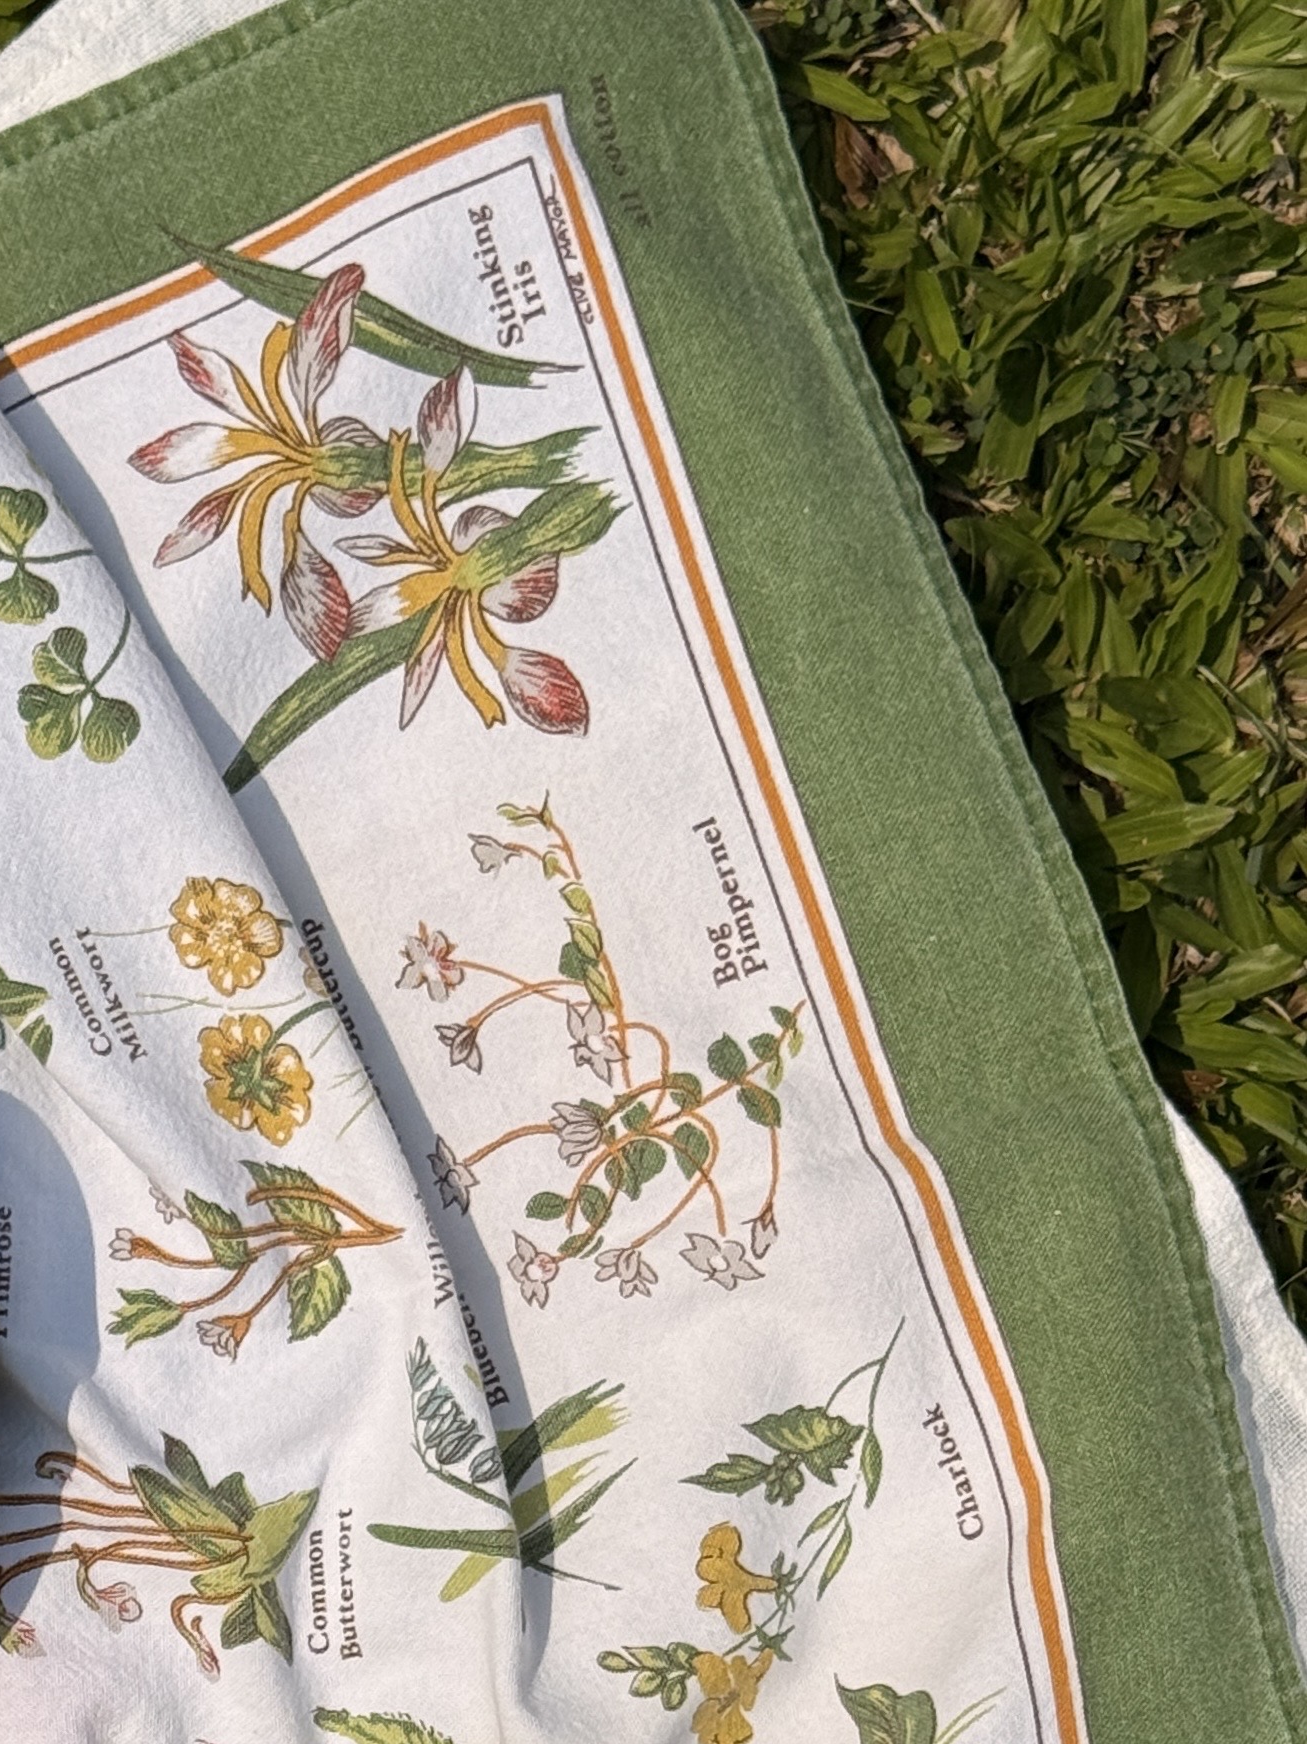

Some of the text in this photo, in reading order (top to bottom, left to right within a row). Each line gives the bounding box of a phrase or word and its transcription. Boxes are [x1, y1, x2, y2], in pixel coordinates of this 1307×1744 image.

[468, 204, 524, 348] Stinking
[544, 173, 578, 260] MAYOR
[514, 260, 546, 325] Iris
[691, 815, 769, 978] Pimpernel
[706, 922, 741, 990] Bog
[48, 936, 113, 1058] Common
[76, 925, 149, 1064] Milkwort
[921, 1401, 984, 1541] Charlock
[306, 1528, 330, 1655] Common
[337, 1507, 364, 1661] Butterwort
